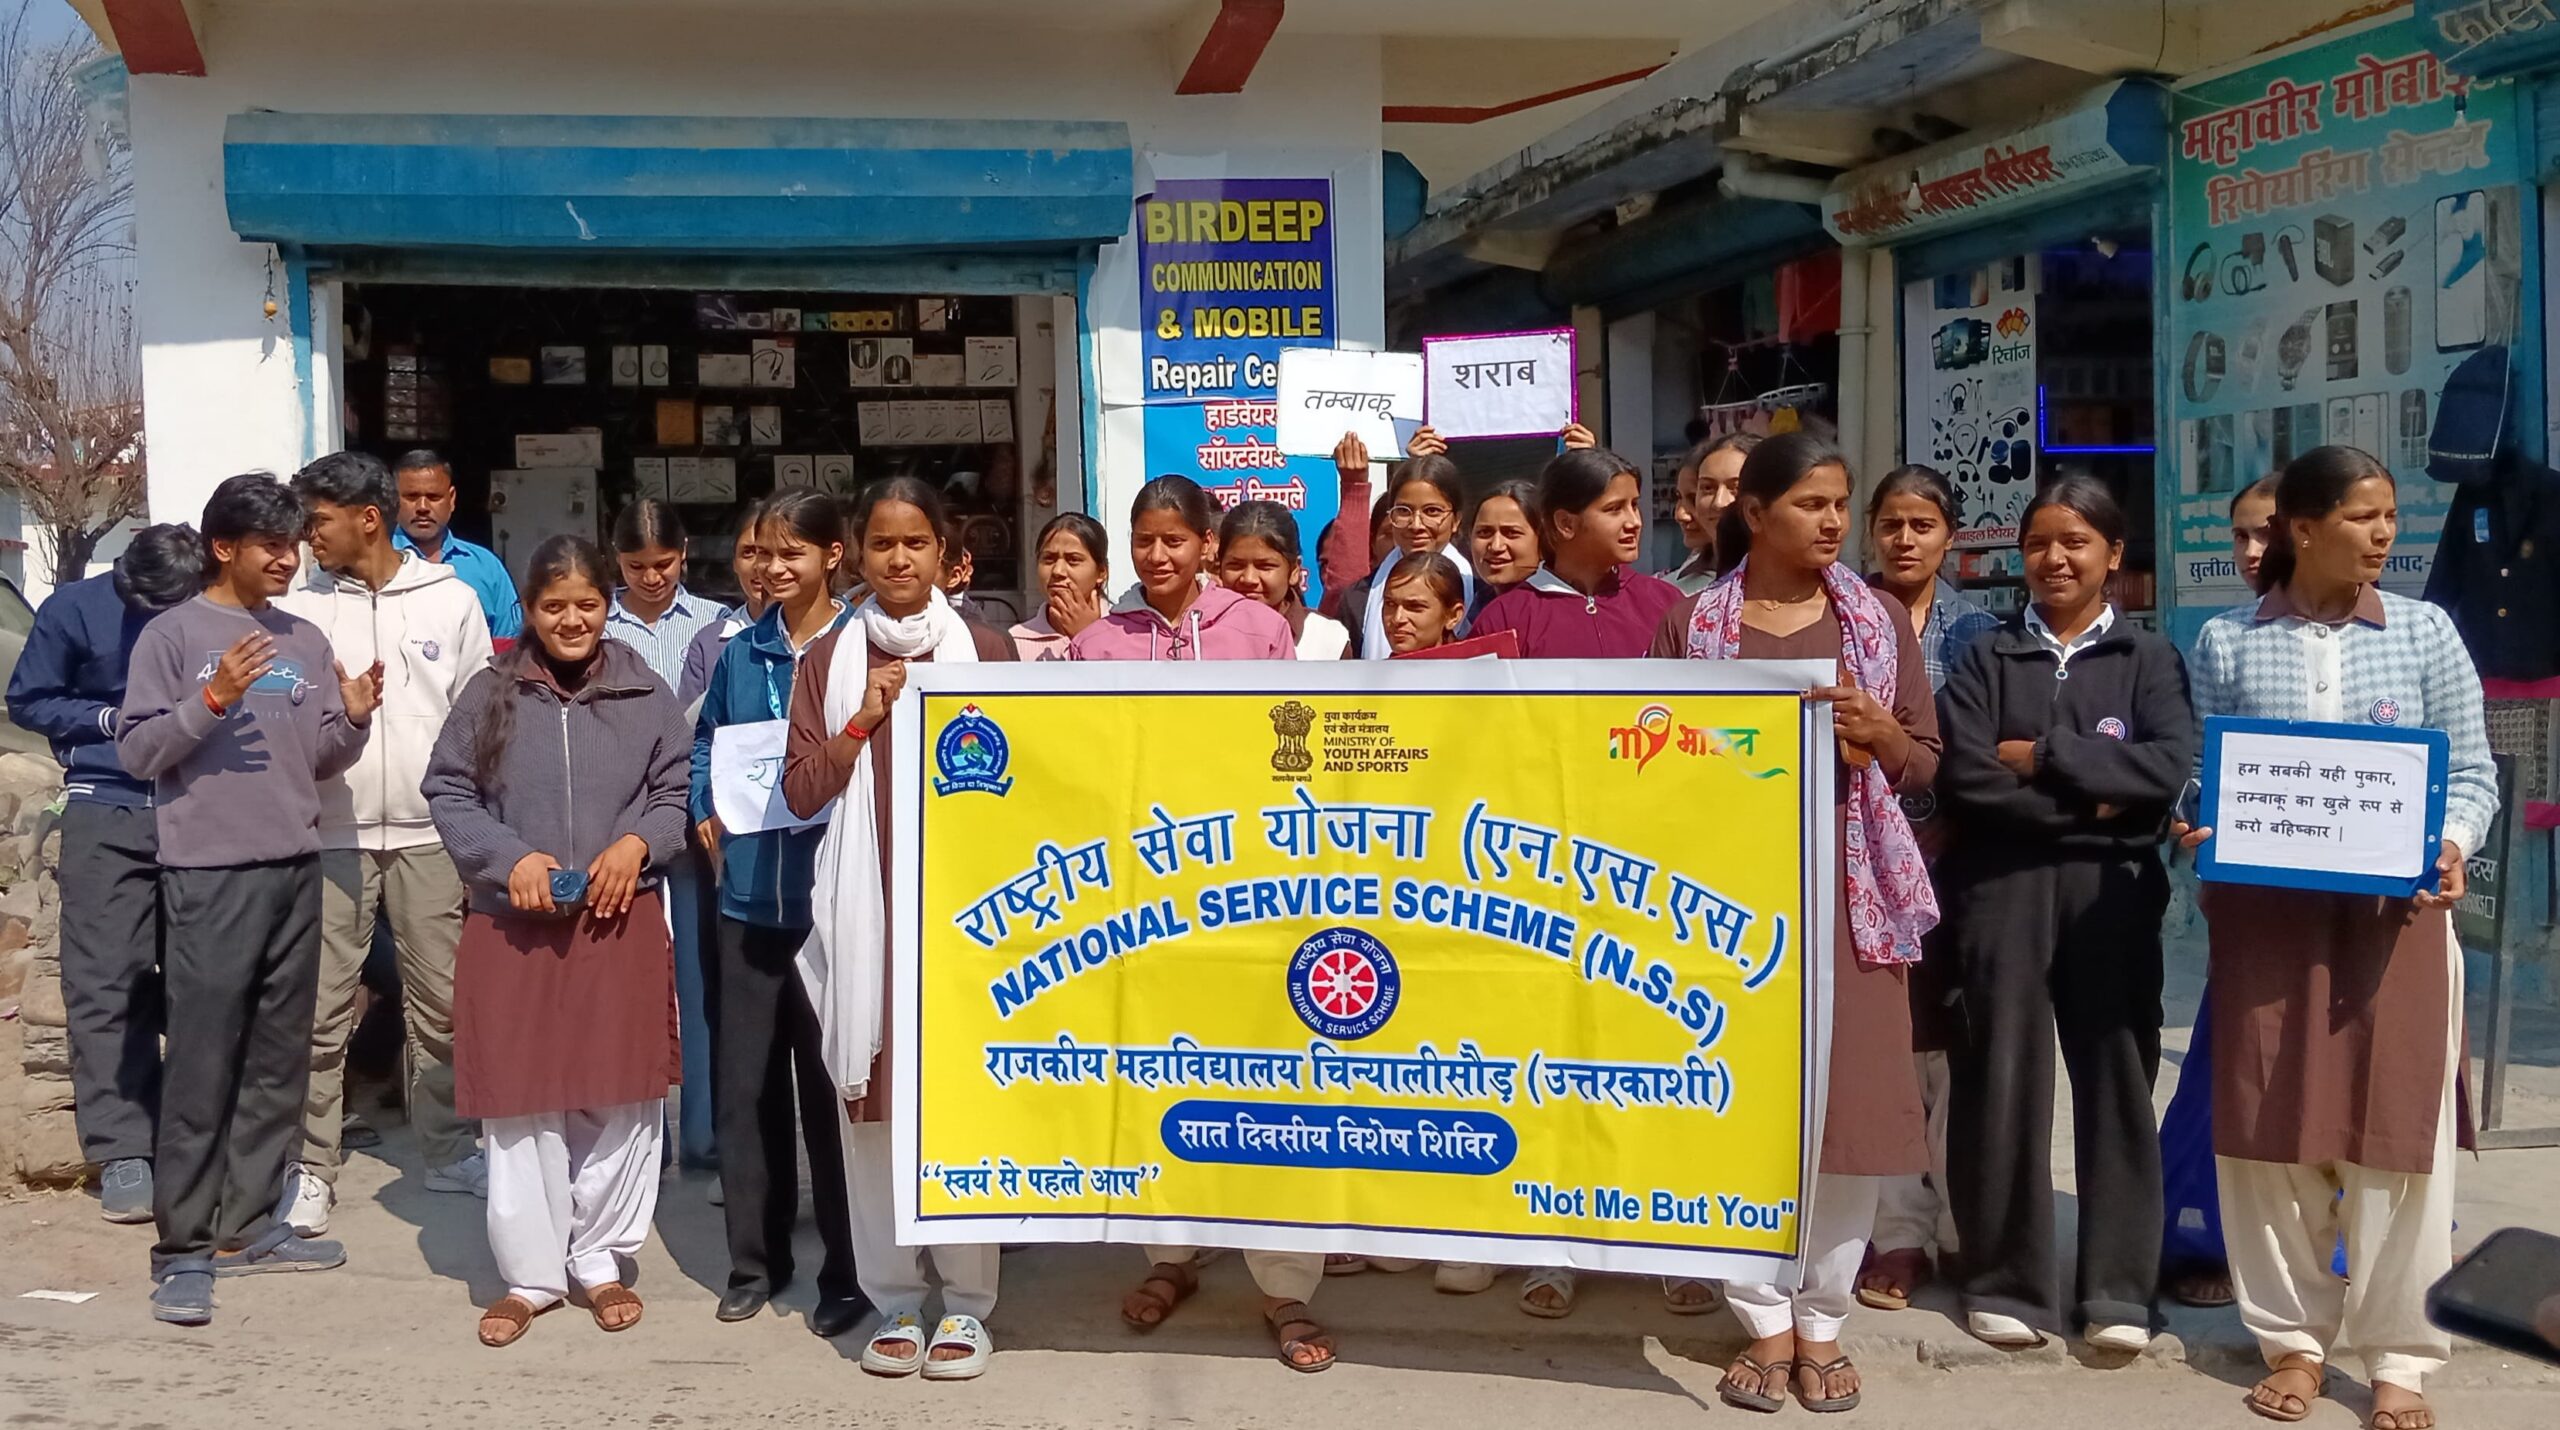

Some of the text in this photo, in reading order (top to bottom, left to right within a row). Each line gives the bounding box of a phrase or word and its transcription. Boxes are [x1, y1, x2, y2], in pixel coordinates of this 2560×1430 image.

[2183, 52, 2514, 167] महावीर मोबा
[1146, 200, 1324, 244] BIRDEEP
[1152, 260, 1322, 293] COMMUNICATION
[1156, 306, 1322, 340] & MOBILE
[1150, 354, 1277, 397] Repair Ce
[1452, 359, 1537, 389] शराब
[1304, 390, 1396, 421] तम्बाकू
[1323, 736, 1396, 747] MINISTRY OF
[1323, 748, 1429, 760] YOUTH AFFAIRS
[1323, 761, 1409, 773] AND SPORTS
[2237, 761, 2262, 777] हम
[2268, 760, 2313, 780] सबकी
[2319, 765, 2347, 782] यही
[2235, 790, 2404, 816] तम्बाकू का खुले रूप से
[2234, 816, 2262, 834] करो
[2269, 818, 2332, 839] बहिष्कार
[955, 841, 1111, 948] राष्ट्रीय
[1133, 806, 1235, 875] सेवा
[1263, 787, 1431, 859] योजना
[989, 877, 1725, 1049] NATIONAL SERVICE SCHEME (N.S.S)
[1294, 930, 1393, 975] राष्ट्रीय सेवा योजना
[1291, 981, 1396, 1035] NATIONAL SERVICE SCHEME
[985, 1034, 1731, 1113] राजकीय महाविद्यालय चिन्यालीसौड़ (उत्तरकाशी)
[1178, 1111, 1499, 1165] सात दिवसीय विशेष शिविर
[998, 1158, 1021, 1196] से
[1029, 1159, 1085, 1197] पहले
[1513, 1183, 1795, 1232] "Not Me But You"
